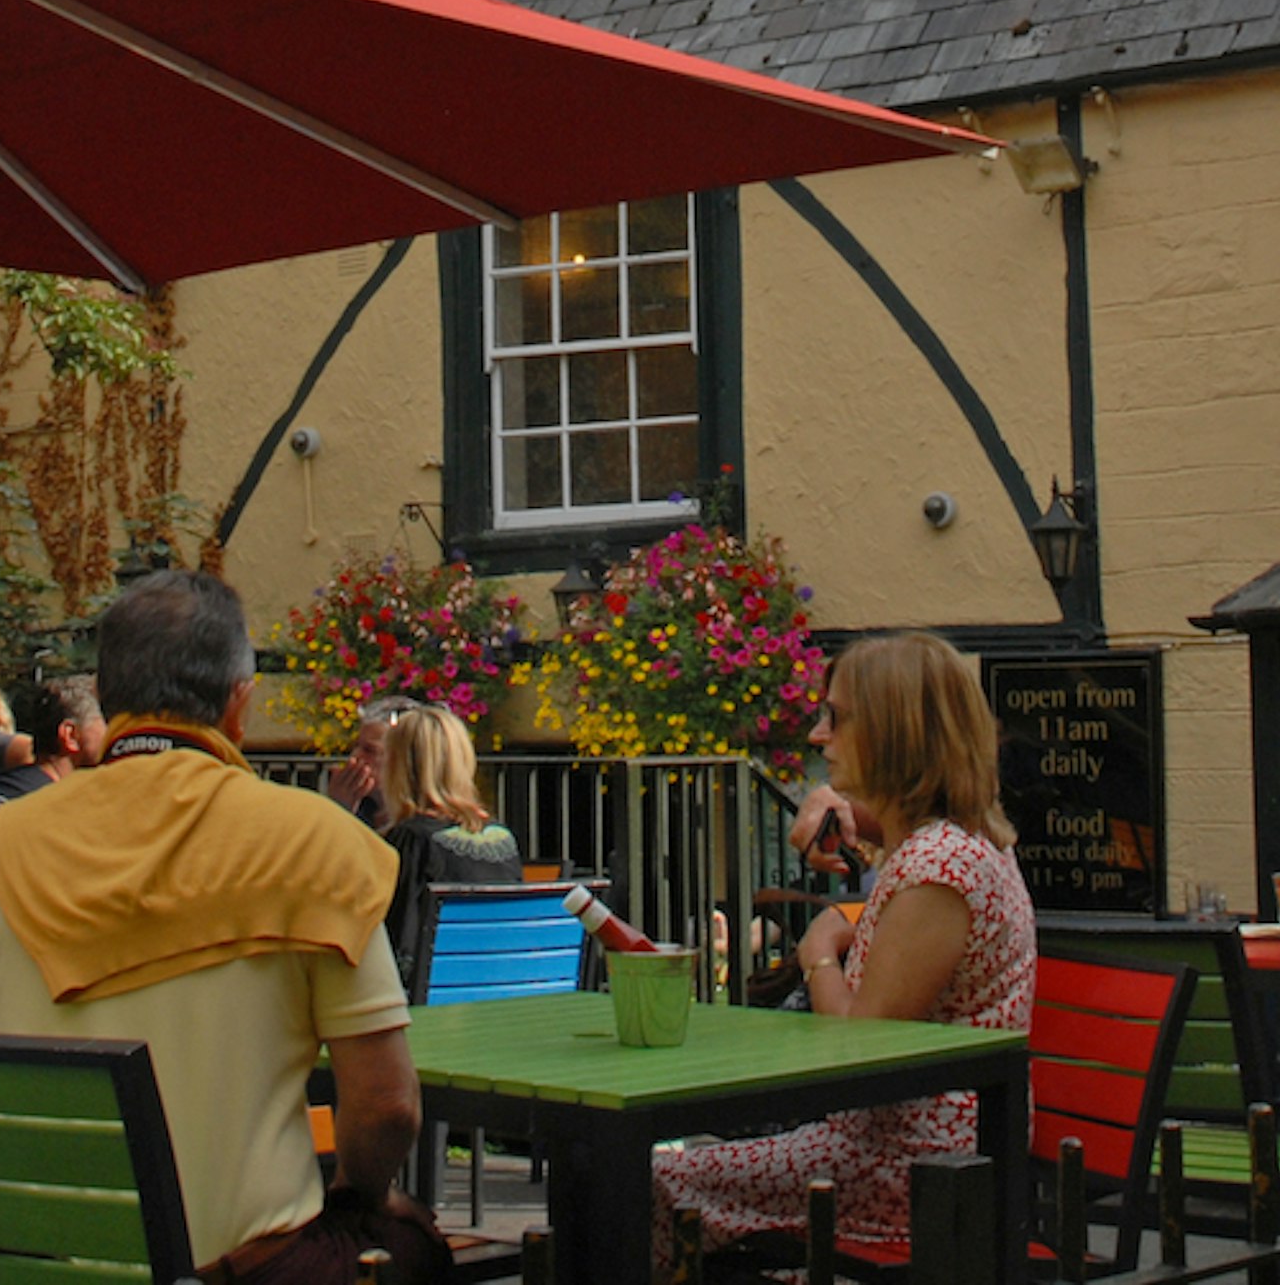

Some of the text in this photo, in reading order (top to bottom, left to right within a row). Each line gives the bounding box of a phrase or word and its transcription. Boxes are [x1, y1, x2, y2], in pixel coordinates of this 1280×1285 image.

[1006, 681, 1136, 714] open from
[1040, 716, 1108, 741] 11am
[111, 735, 173, 756] Canon
[1041, 748, 1103, 781] daily
[1046, 808, 1105, 836] food
[1084, 839, 1134, 867] daily
[1091, 871, 1124, 893] pm
